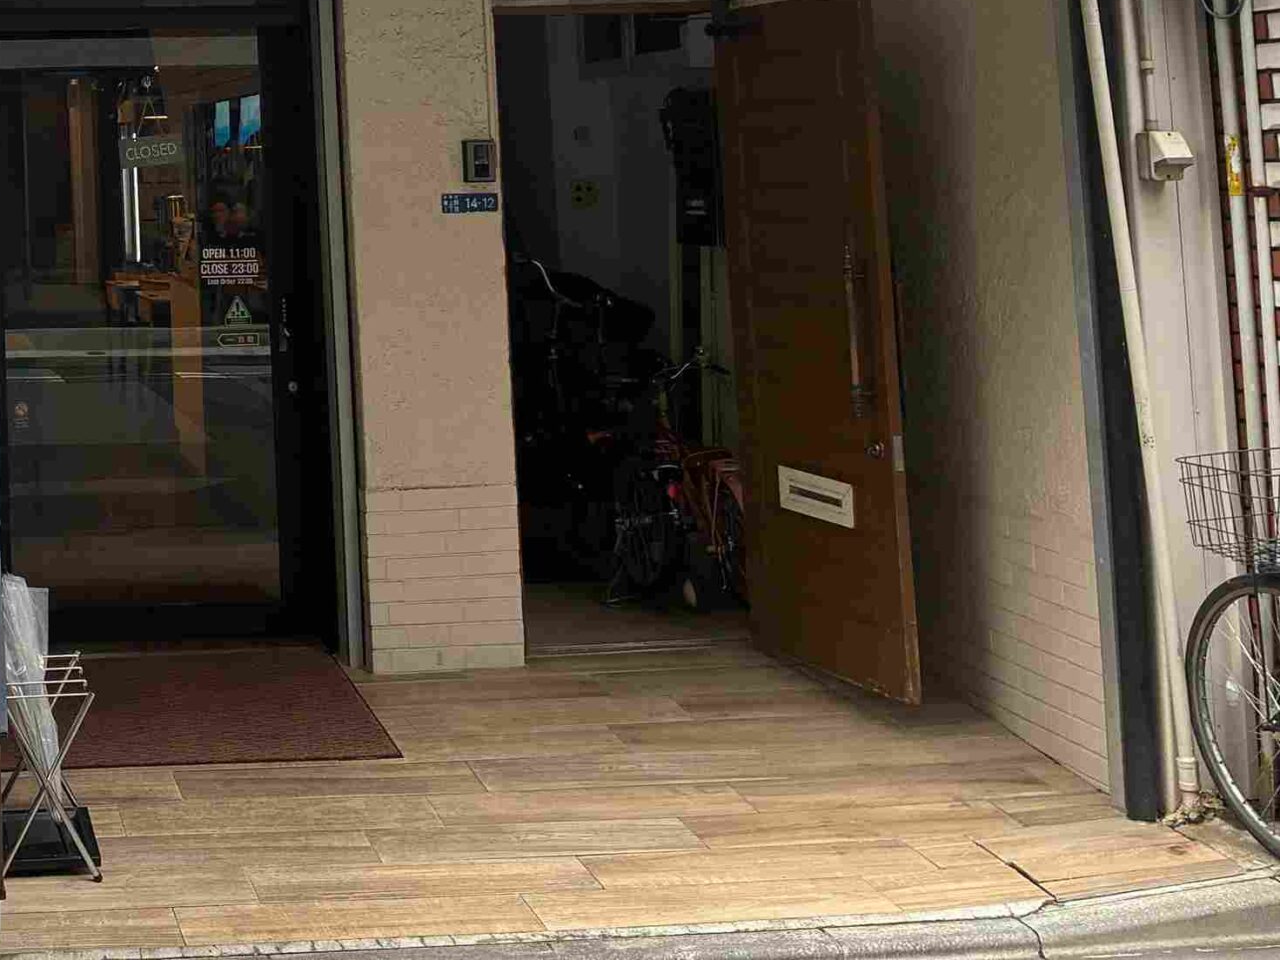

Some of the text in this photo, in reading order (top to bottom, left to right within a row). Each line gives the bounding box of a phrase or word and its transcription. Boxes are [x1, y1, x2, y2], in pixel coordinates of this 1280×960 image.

[126, 142, 177, 161] CLOSED
[202, 248, 256, 260] OPEN 11:00
[201, 263, 259, 275] CLOSE 23:00
